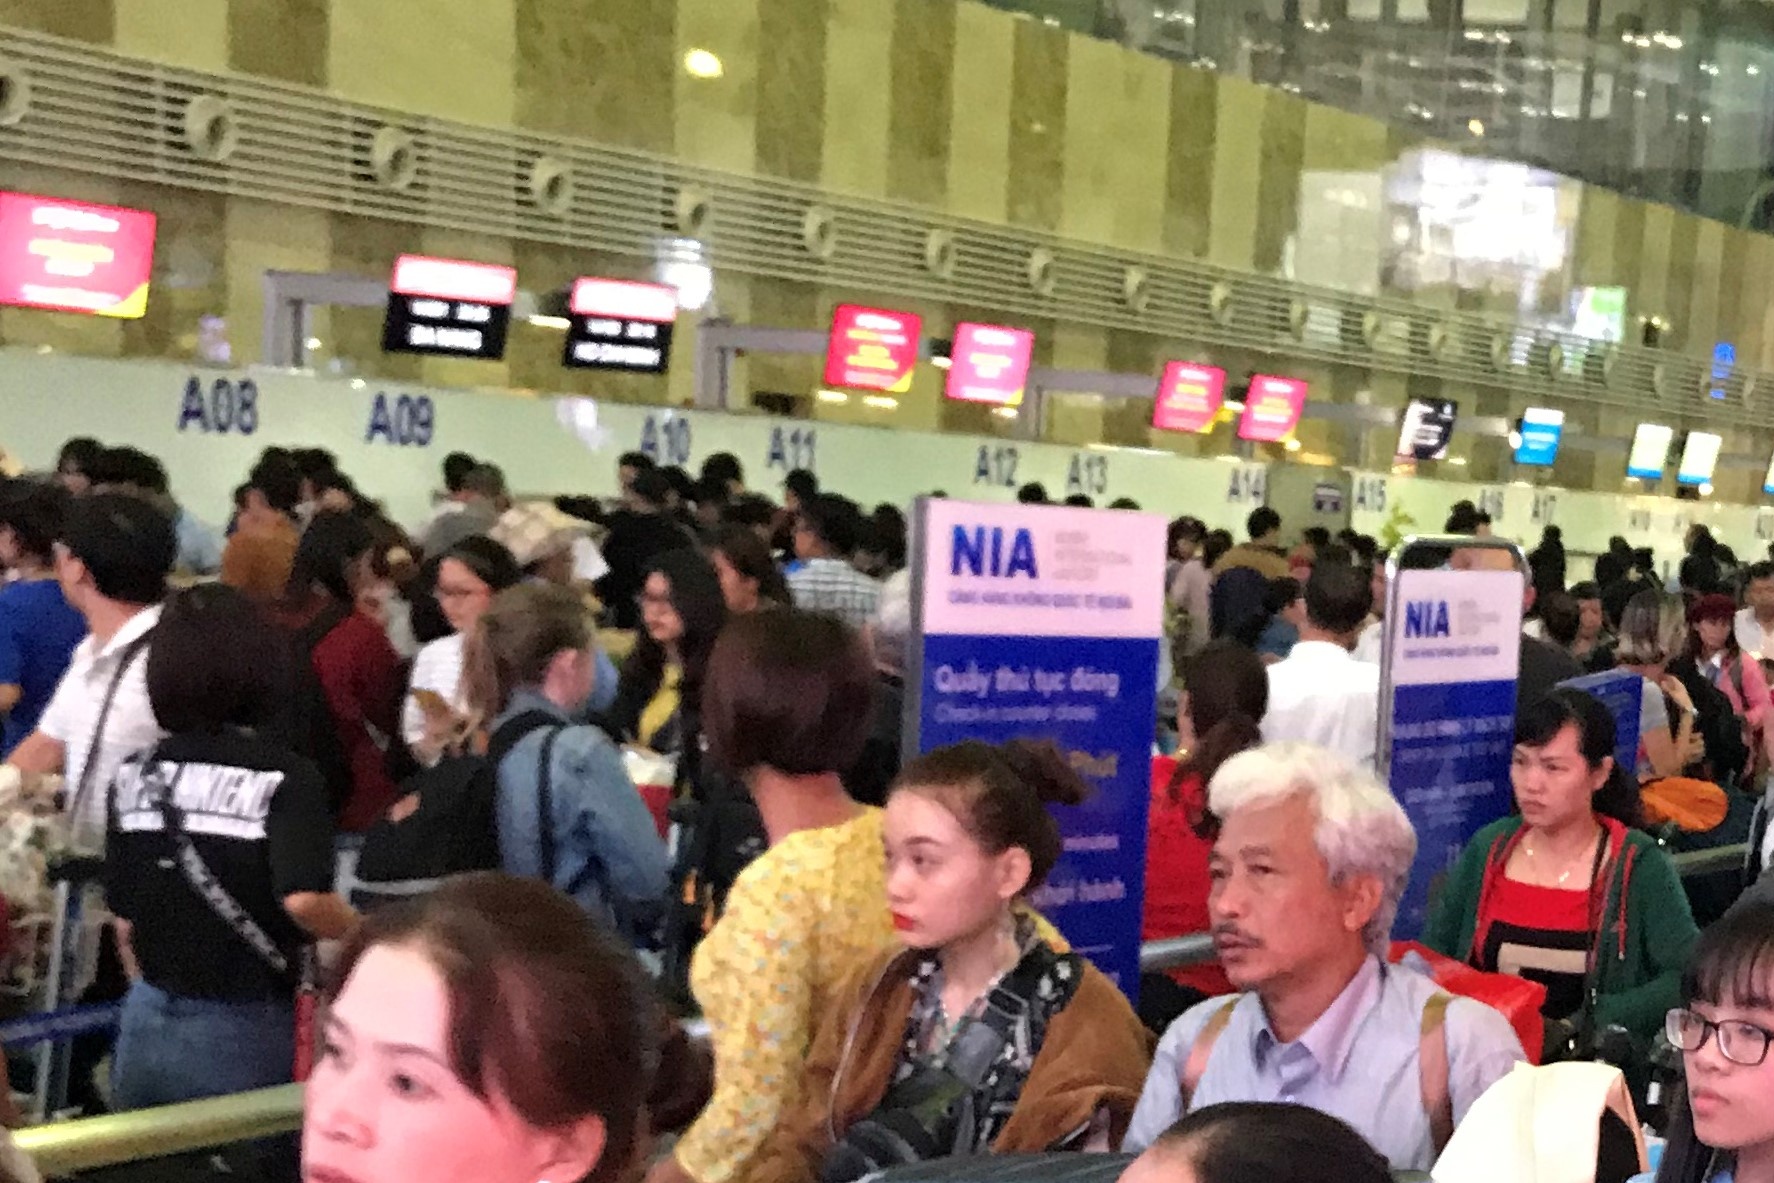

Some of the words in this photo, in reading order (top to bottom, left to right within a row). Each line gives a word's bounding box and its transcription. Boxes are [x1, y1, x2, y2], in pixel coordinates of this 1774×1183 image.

[177, 376, 258, 433] A08
[365, 391, 435, 446] A09
[974, 445, 1018, 487] A12
[951, 523, 1039, 580] NIA
[1404, 599, 1451, 639] NIA
